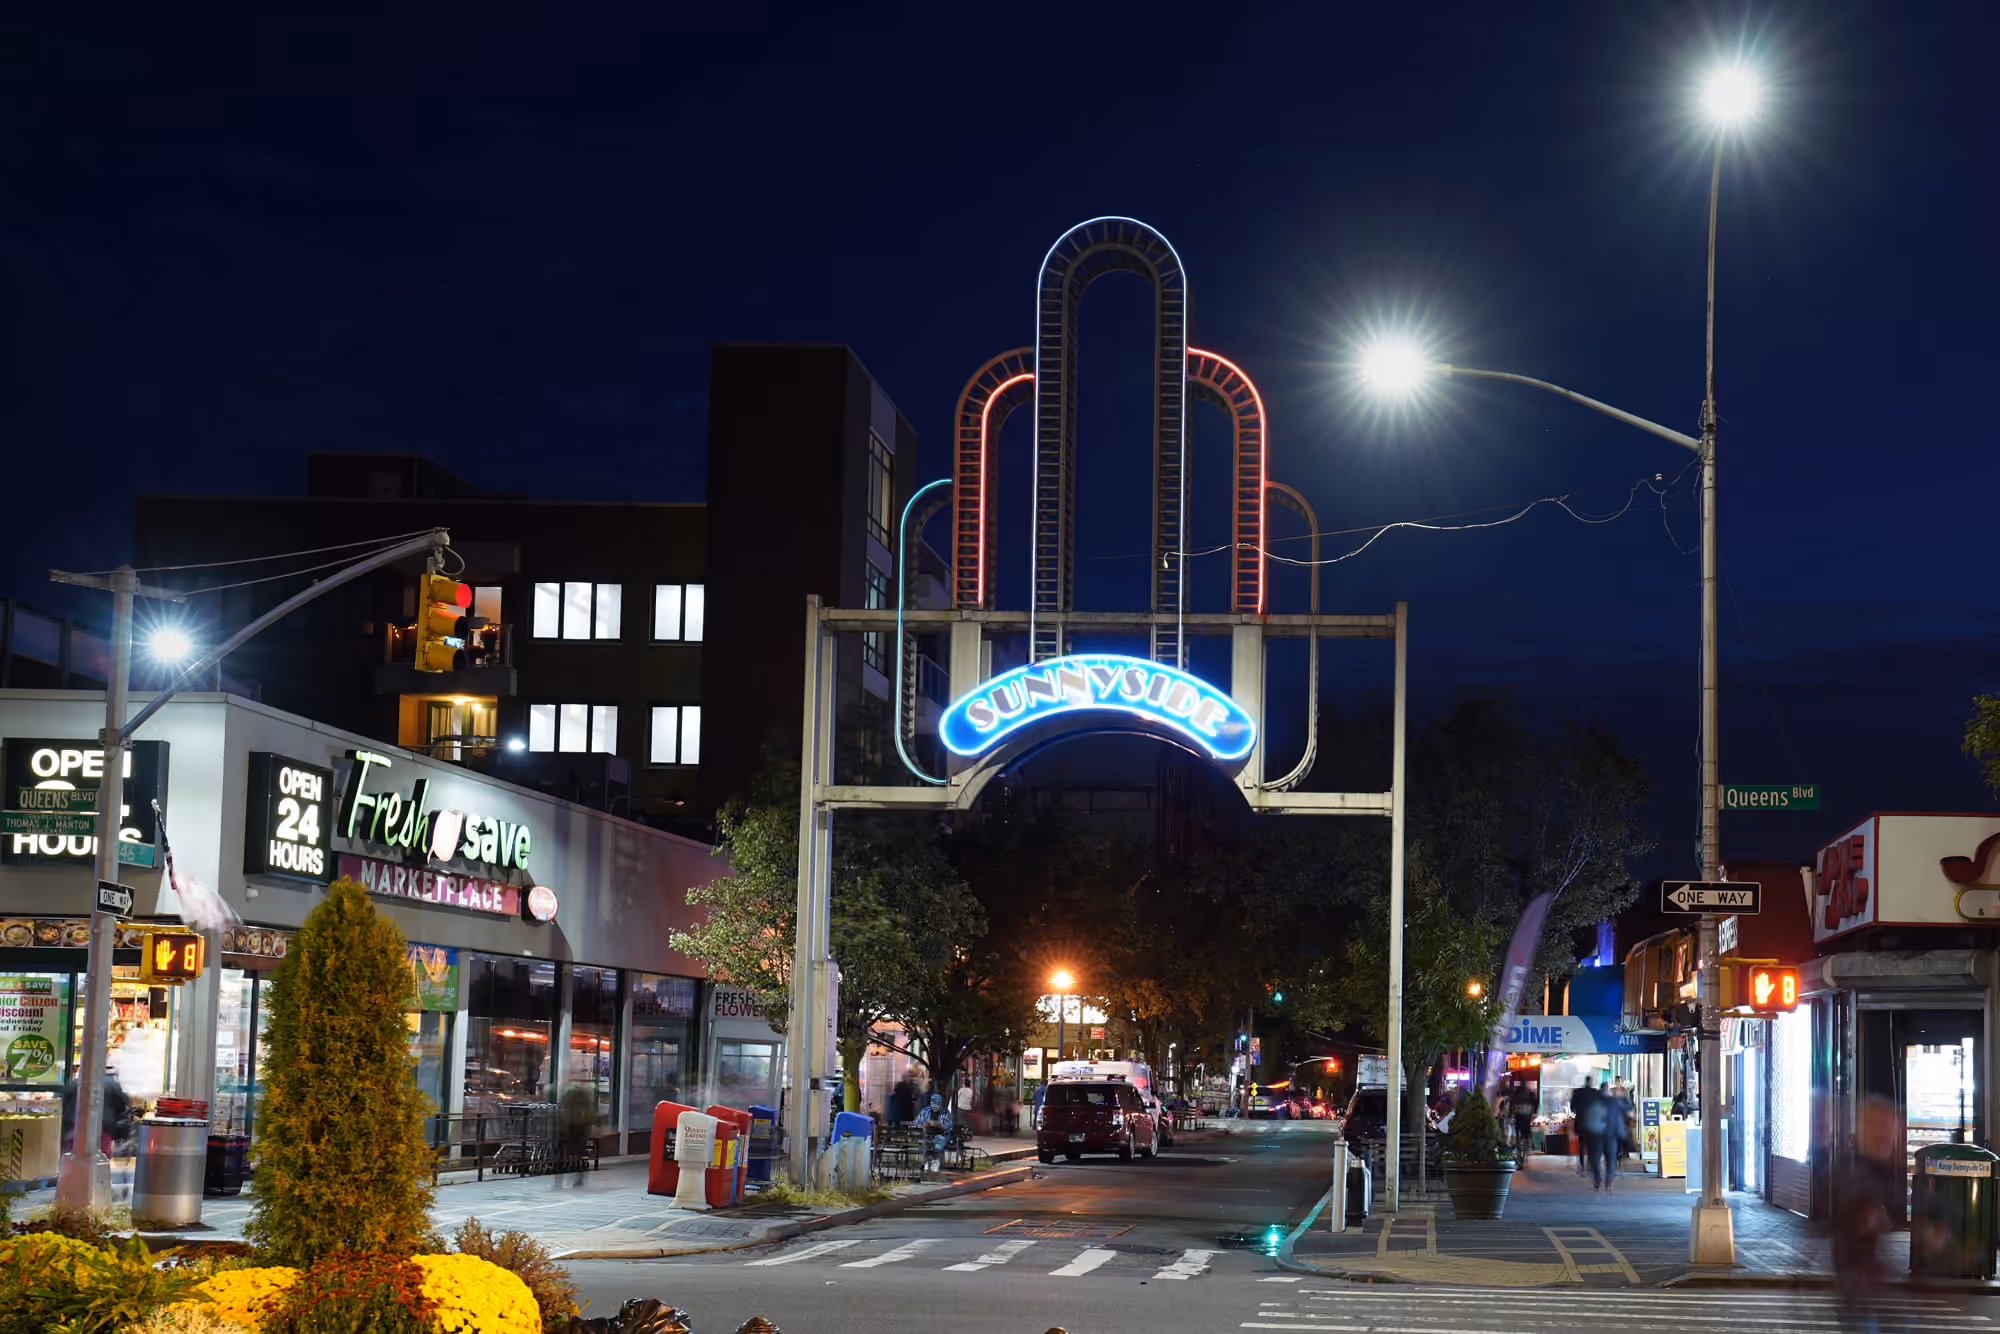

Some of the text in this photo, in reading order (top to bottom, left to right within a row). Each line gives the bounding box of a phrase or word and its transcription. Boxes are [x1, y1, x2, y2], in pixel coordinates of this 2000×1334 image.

[967, 663, 1231, 736] SUNNYSIDE
[279, 766, 323, 802] OPEN
[1727, 786, 1814, 808] Queens Blvd
[19, 790, 69, 809] QUEENS
[347, 750, 430, 853] Fresh
[275, 797, 321, 846] 24
[464, 813, 532, 870] save
[269, 839, 324, 875] HOURS
[103, 889, 115, 905] ONE
[360, 860, 503, 911] MARKETPLACE
[1677, 891, 1747, 905] ONE WAY
[183, 943, 197, 971] 8
[716, 992, 754, 1004] FRESH
[1782, 975, 1796, 1006] 8
[13, 1040, 48, 1049] SAVE
[1618, 1034, 1639, 1046] ATM
[11, 1048, 53, 1071] 7%
